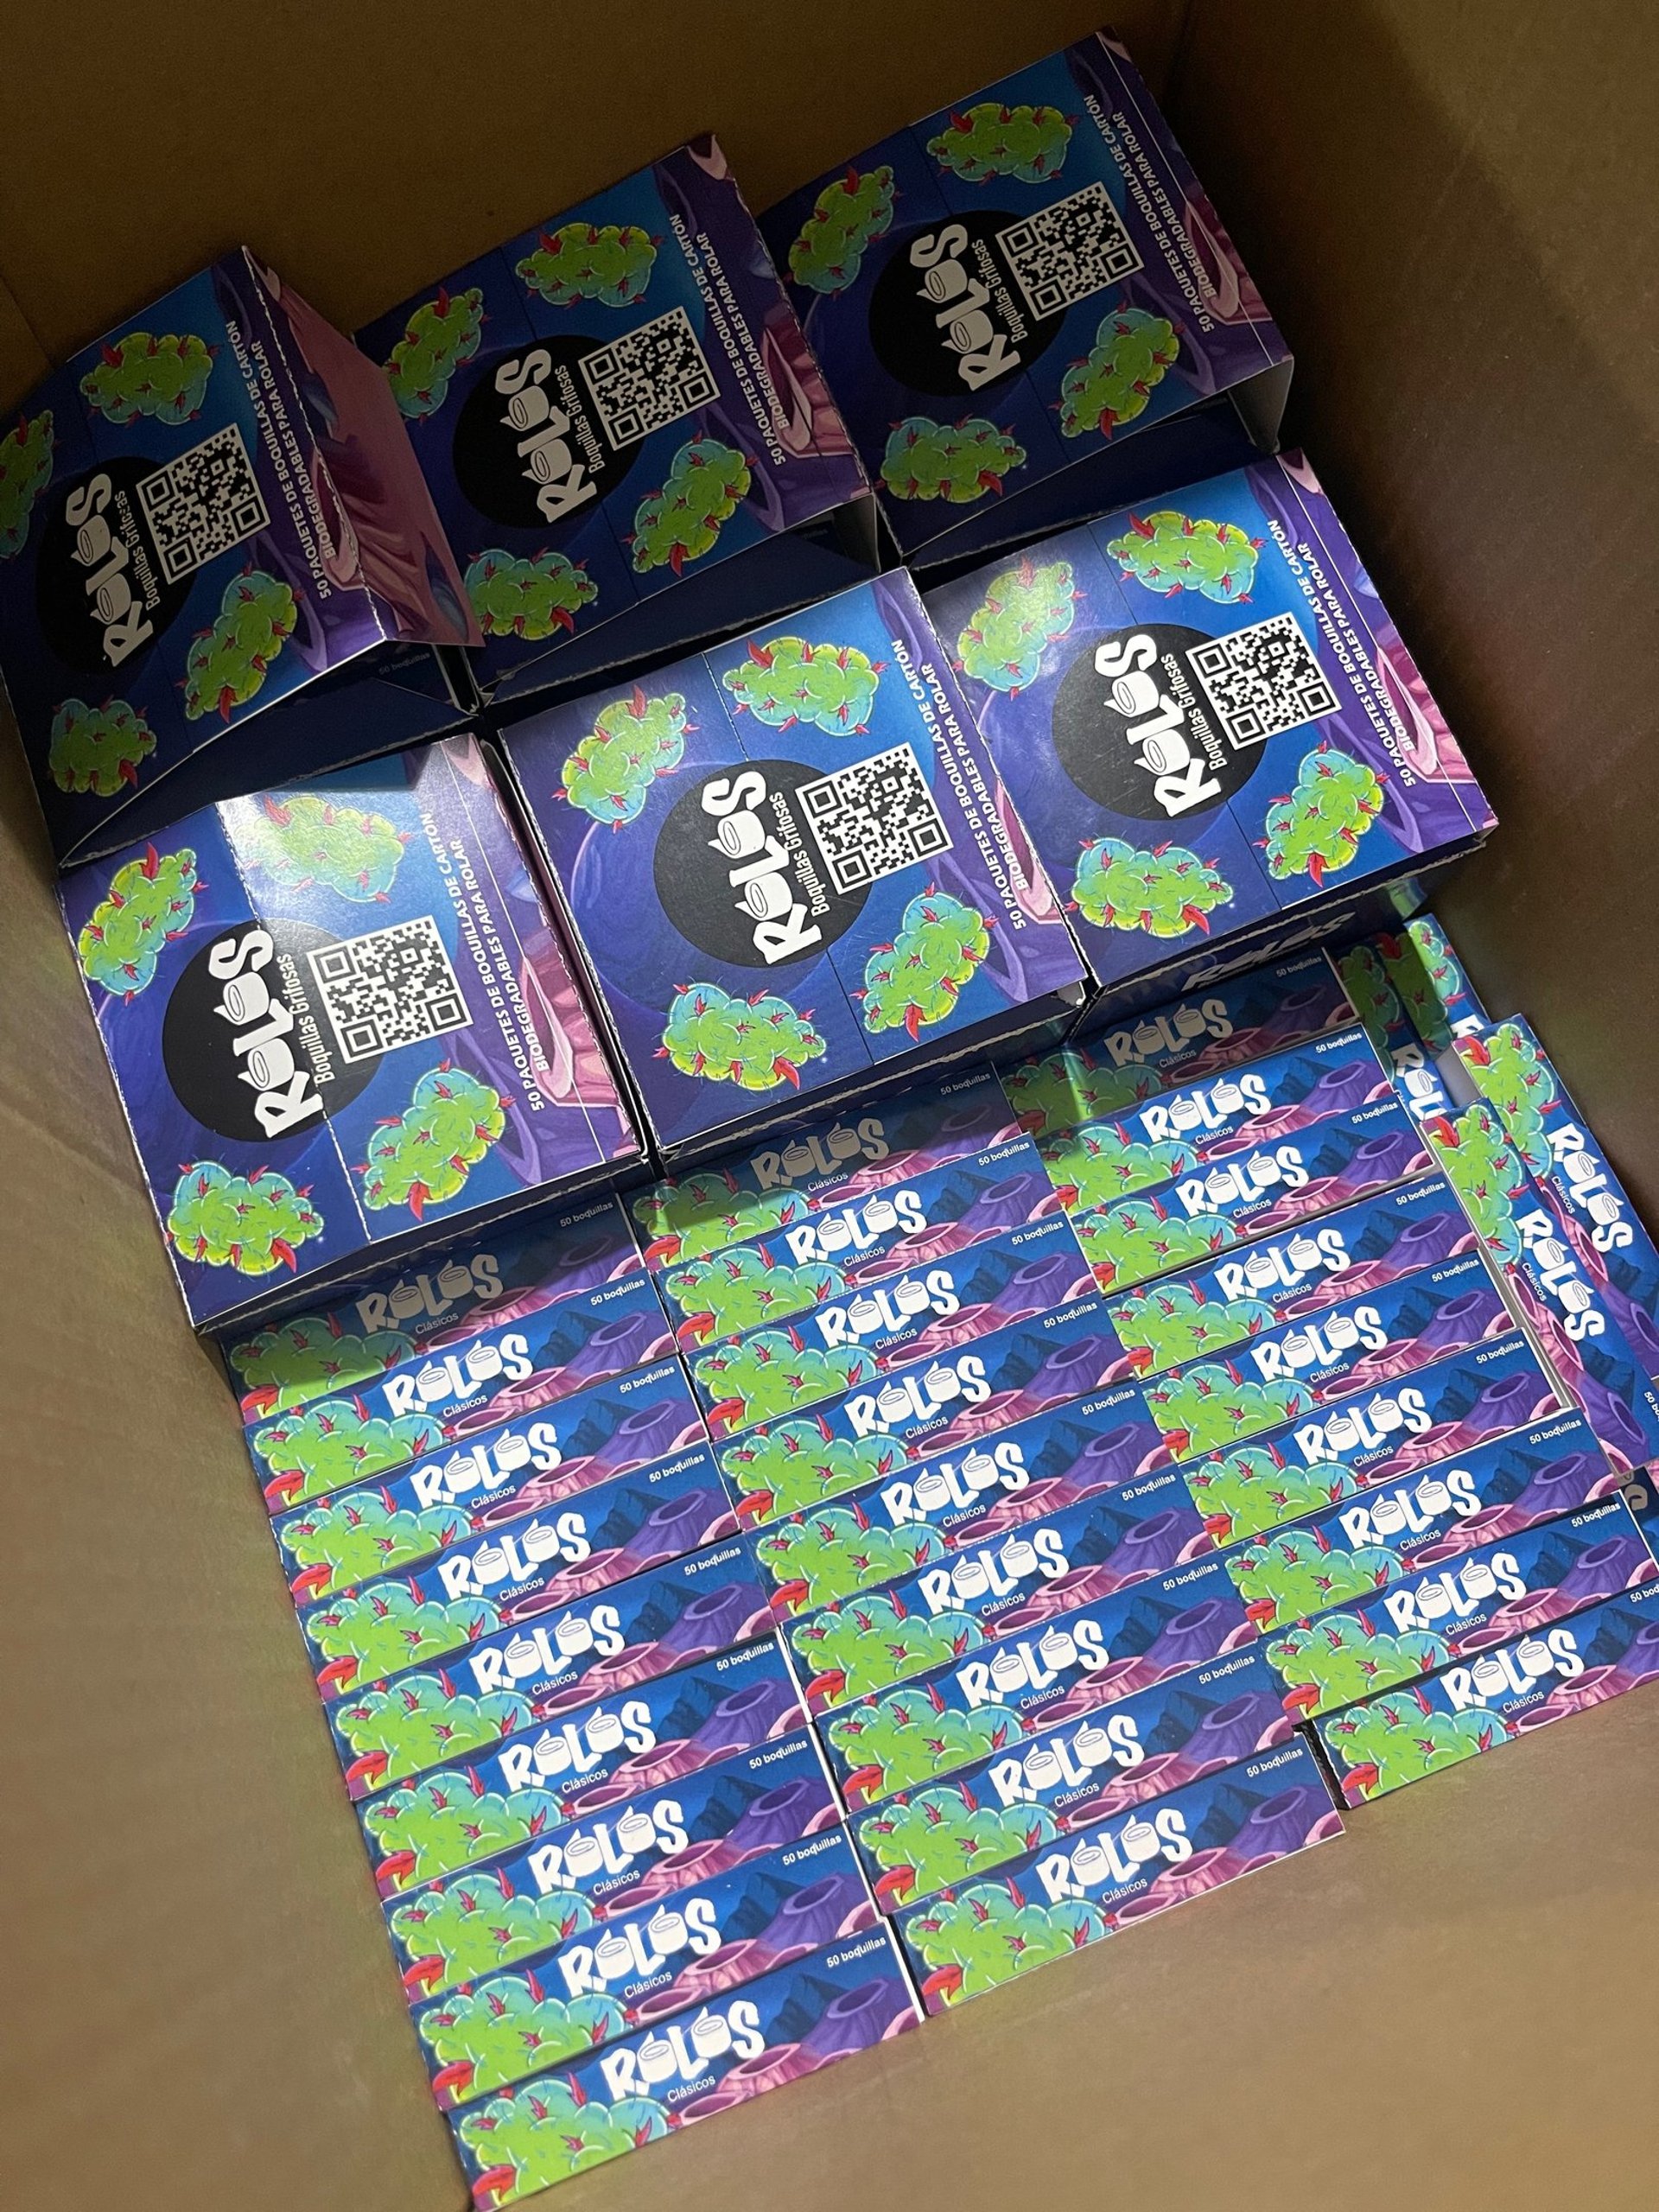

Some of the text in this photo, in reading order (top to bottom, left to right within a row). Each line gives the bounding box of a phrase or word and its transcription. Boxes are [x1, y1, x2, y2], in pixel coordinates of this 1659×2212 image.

[1109, 143, 1126, 162] DE
[1110, 109, 1217, 297] BIODEGRADABLES PARA ROLAR
[1118, 162, 1162, 232] BOQUILLAS
[1154, 230, 1172, 250] DE
[691, 266, 708, 286] DE
[969, 238, 1029, 343] Boquillas Grifosas
[1163, 248, 1205, 315] PAQUETES
[695, 230, 790, 429] BIODEGRADABLES PARA ROLAR
[699, 285, 740, 359] BOQUILLAS
[1197, 313, 1215, 333] 50
[245, 378, 261, 400] DE
[731, 358, 748, 378] DE
[252, 399, 289, 481] BOQUILLAS
[552, 363, 607, 474] Boquillas Grifosas
[739, 377, 778, 448] PAQUETES
[249, 337, 336, 559] BIODEGRADABLES PARA ROLAR
[769, 446, 786, 466] 50
[281, 480, 297, 503] DE
[289, 501, 324, 580] PAQUETES
[130, 543, 162, 609] Boquillas
[315, 577, 332, 601] 50
[1266, 518, 1416, 785] 50 PAQUETES DE BOQUILLAS DE CARTÓN
[1295, 540, 1414, 749] BIODEGRADABLES PARA ROLAR
[1092, 633, 1223, 817] ROLOS
[1159, 652, 1229, 771] Boquillas Grifosas
[890, 638, 1027, 930] 50 PAQUETES DE BOQUILLAS DE CARTÓN
[919, 662, 1029, 890] BIODEGRADABLES PARA ROLAR
[443, 875, 461, 897] DE
[701, 771, 822, 964] ROLOS
[767, 790, 831, 916] Boquillas Grifosas
[448, 837, 550, 1071] BIODEGRADABLES PARA ROLAR
[452, 899, 495, 984] BOQUILLAS
[275, 952, 337, 1085] Boquillas Grifosas
[486, 985, 505, 1007] DE
[208, 931, 325, 1138] ROLOS
[494, 1007, 537, 1090] PAQUETES
[1315, 1032, 1363, 1052] 50 boquillas
[526, 1090, 545, 1112] 50
[1140, 1074, 1271, 1144] ROLOS
[1390, 1043, 1447, 1122] ROL
[977, 1141, 1028, 1165] 50 boquillas
[1195, 1126, 1234, 1145] Clásicos
[1176, 1146, 1308, 1218] ROLOS
[1233, 1198, 1272, 1219] Clásicos
[1395, 1182, 1445, 1205] 50 boquillas
[1551, 1175, 1576, 1215] Clásicos
[785, 1190, 926, 1267] ROLOS
[843, 1245, 886, 1267] Clásicos
[589, 1279, 645, 1306] 50 boquillas
[1214, 1229, 1351, 1303] ROLOS
[1522, 1261, 1547, 1302] Clásicos
[816, 1270, 959, 1350] ROLOS
[874, 1328, 918, 1351] Clásicos
[1043, 1301, 1096, 1327] 50 boquillas
[1251, 1306, 1388, 1383] ROLOS
[383, 1334, 532, 1419] ROLOS
[1310, 1362, 1350, 1383] Clásicos
[1476, 1339, 1525, 1363] 50 boquillas
[442, 1395, 487, 1418] Clásicos
[844, 1355, 991, 1440] ROLOS
[1294, 1388, 1432, 1467] ROLOS
[410, 1422, 561, 1510] ROLOS
[471, 1484, 516, 1510] Clásicos
[648, 1455, 704, 1483] 50 boquillas
[880, 1442, 1029, 1529] ROLOS
[1122, 1474, 1176, 1501] 50 boquillas
[943, 1504, 987, 1528] Clásicos
[1339, 1470, 1481, 1551] ROLOS
[1400, 1529, 1441, 1552] Clásicos
[1571, 1503, 1621, 1527] 50 boquillas
[438, 1512, 590, 1603] ROLOS
[918, 1529, 1069, 1617] ROLOS
[1384, 1553, 1526, 1635] ROLOS
[1446, 1613, 1487, 1636] Clásicos
[469, 1605, 625, 1696] ROLOS
[531, 1670, 578, 1696] Clásicos
[715, 1642, 773, 1670] 50 boquillas
[957, 1619, 1109, 1711] ROLOS
[1198, 1655, 1255, 1684] 50 boquillas
[1440, 1629, 1584, 1713] ROLOS
[1020, 1685, 1065, 1710] Clásicos
[1503, 1691, 1545, 1714] Clásicos
[499, 1700, 656, 1795] ROLOS
[988, 1714, 1144, 1809] ROLOS
[1054, 1783, 1100, 1808] Clásicos
[528, 1800, 688, 1897] ROLOS
[593, 1870, 640, 1897] Clásicos
[782, 1834, 842, 1865] 50 boquillas
[1036, 1808, 1192, 1906] ROLOS
[1102, 1878, 1148, 1905] Clásicos
[558, 1898, 721, 2000] ROLOS
[826, 1936, 887, 1967] 50 boquillas
[624, 1971, 672, 1999] Clásicos
[601, 2001, 764, 2104] ROLOS
[667, 2075, 715, 2103] Clásicos
